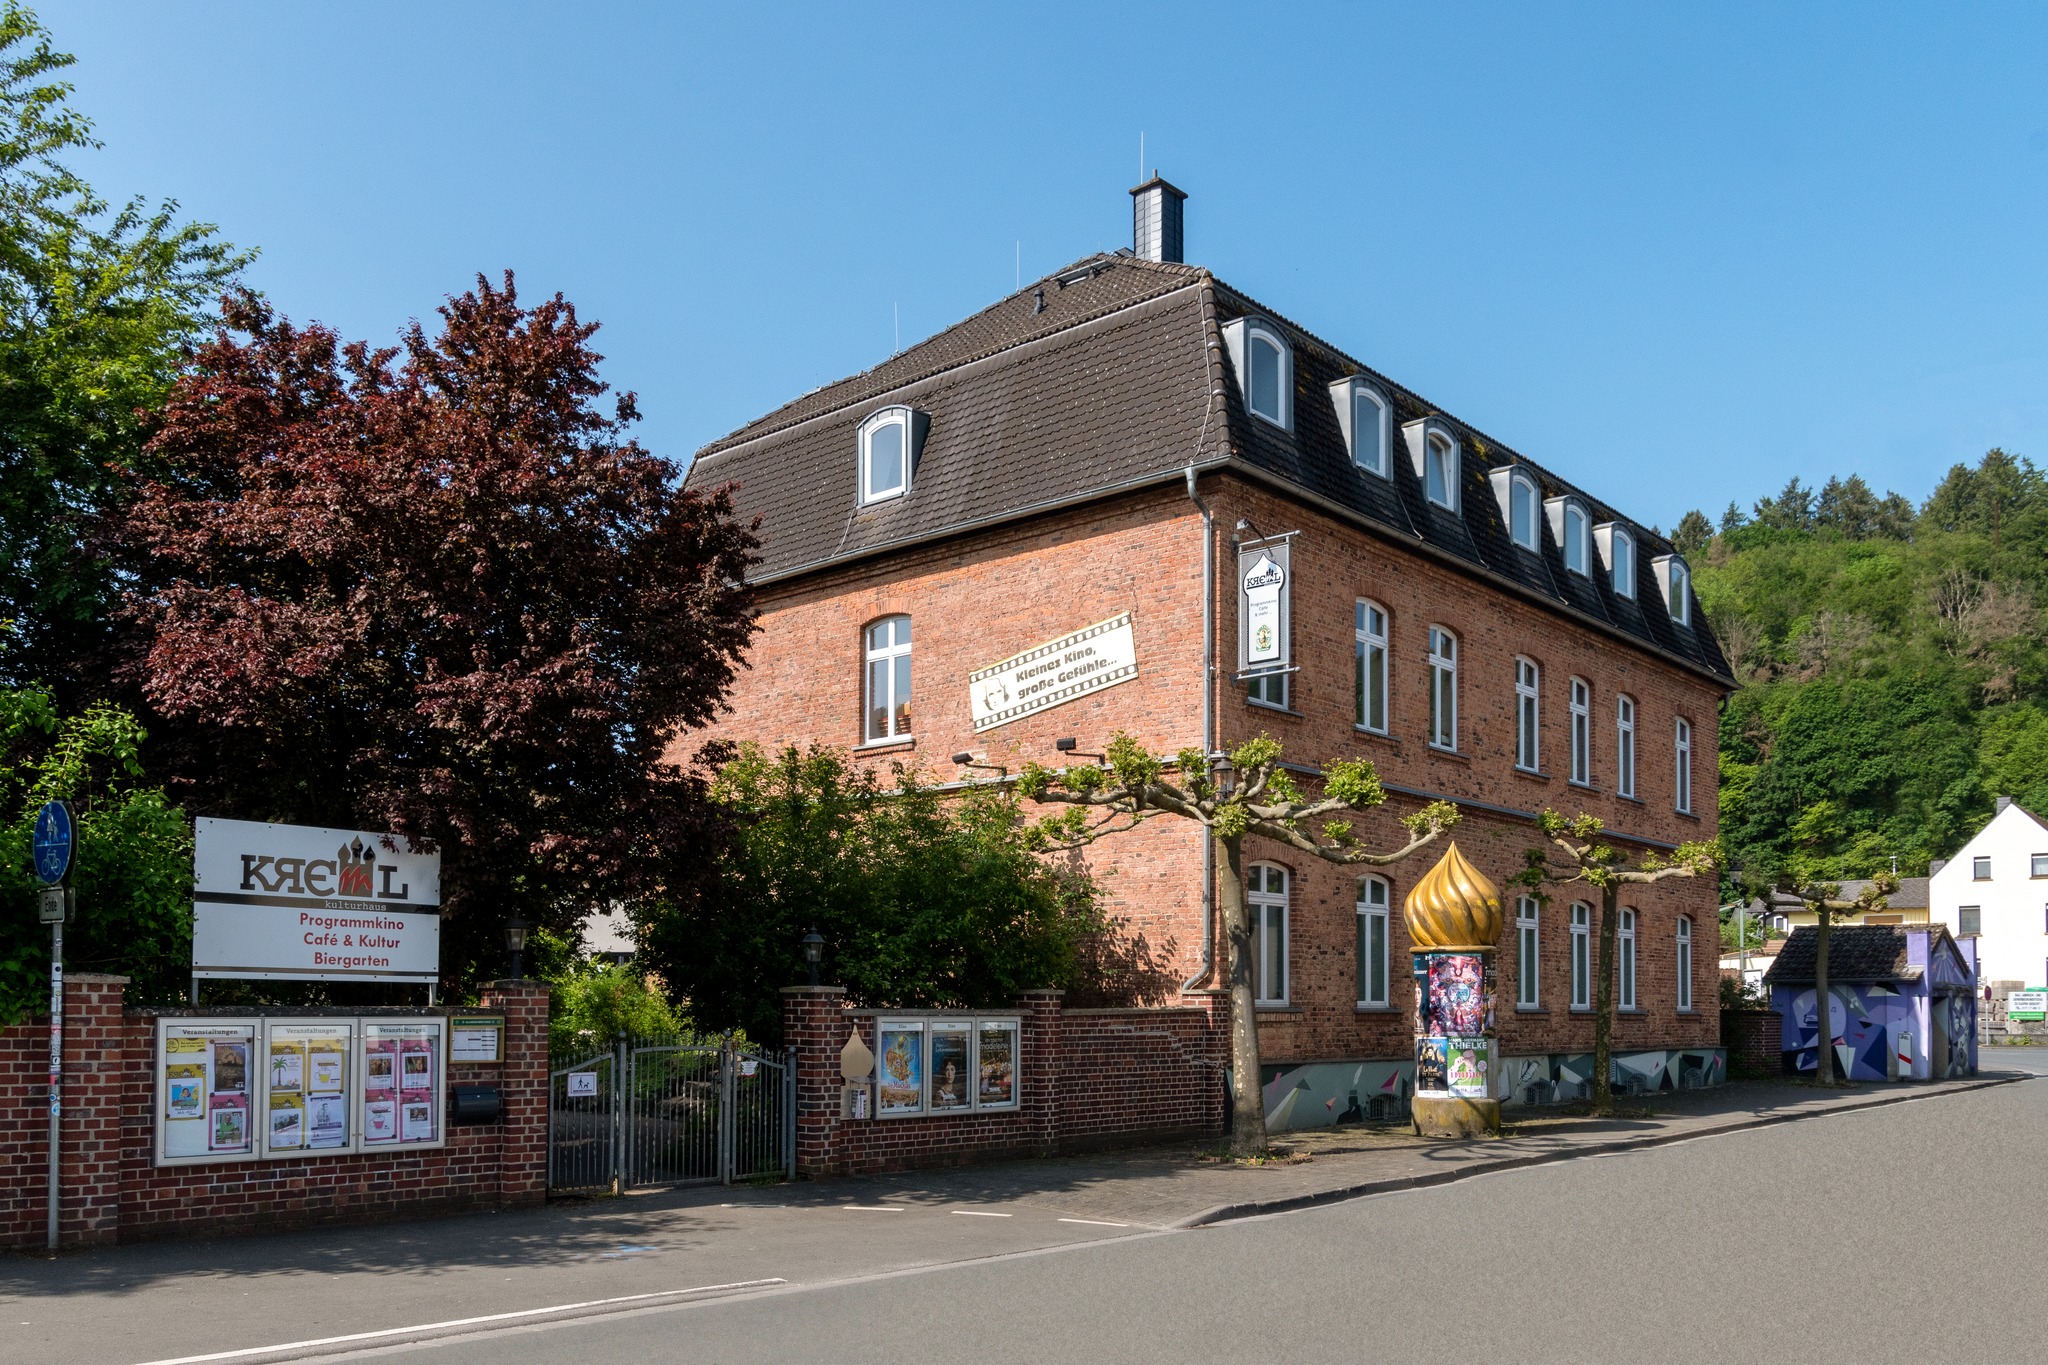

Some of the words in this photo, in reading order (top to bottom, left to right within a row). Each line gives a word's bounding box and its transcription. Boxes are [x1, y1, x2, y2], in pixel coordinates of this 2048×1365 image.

[1016, 659, 1061, 683] Kleines
[1064, 646, 1097, 665] Kino,
[1018, 678, 1054, 700] große
[1057, 657, 1118, 683] Gefühle...
[45, 896, 58, 912] Ende
[325, 900, 387, 912] kulturhaus
[300, 912, 405, 930] Programmkino
[303, 932, 338, 947] Café
[343, 935, 354, 947] &
[359, 934, 401, 949] Kultur
[314, 951, 390, 969] Biergarten
[182, 1028, 238, 1037] Veranstaltungen
[286, 1027, 337, 1035] Veranstaltungen
[379, 1027, 426, 1035] Veranstaltungen
[1448, 1042, 1488, 1050] THIELKE
